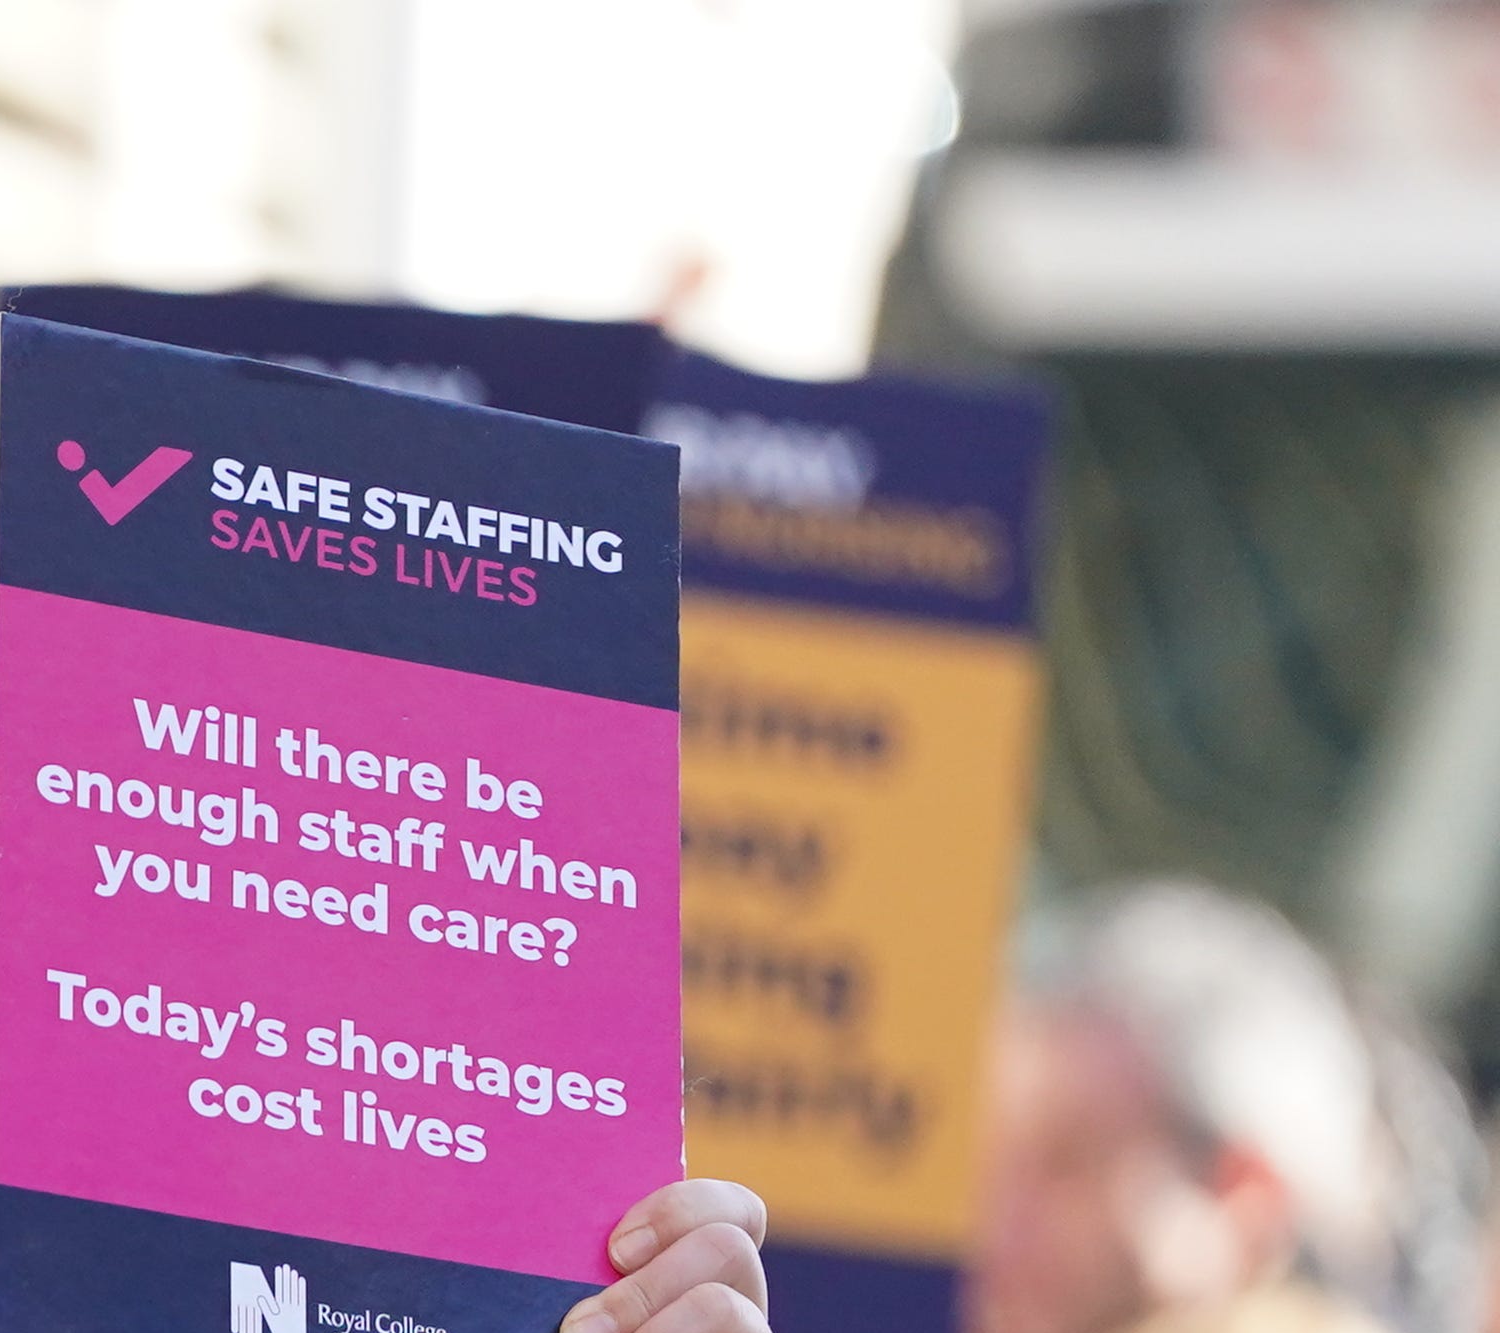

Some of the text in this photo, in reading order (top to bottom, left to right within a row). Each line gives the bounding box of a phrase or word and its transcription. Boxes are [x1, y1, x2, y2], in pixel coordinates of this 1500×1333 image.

[210, 457, 351, 523] SAFE
[362, 487, 623, 573] STAFFING
[210, 509, 537, 607] SAVES LIVES
[133, 698, 543, 819] Will there be
[36, 764, 279, 847] enough
[298, 809, 446, 873] staff
[459, 838, 637, 909] when
[94, 844, 578, 967] you need care?
[46, 968, 288, 1059] Today’s
[305, 1018, 627, 1117] shortages
[188, 1078, 487, 1163] cost lives
